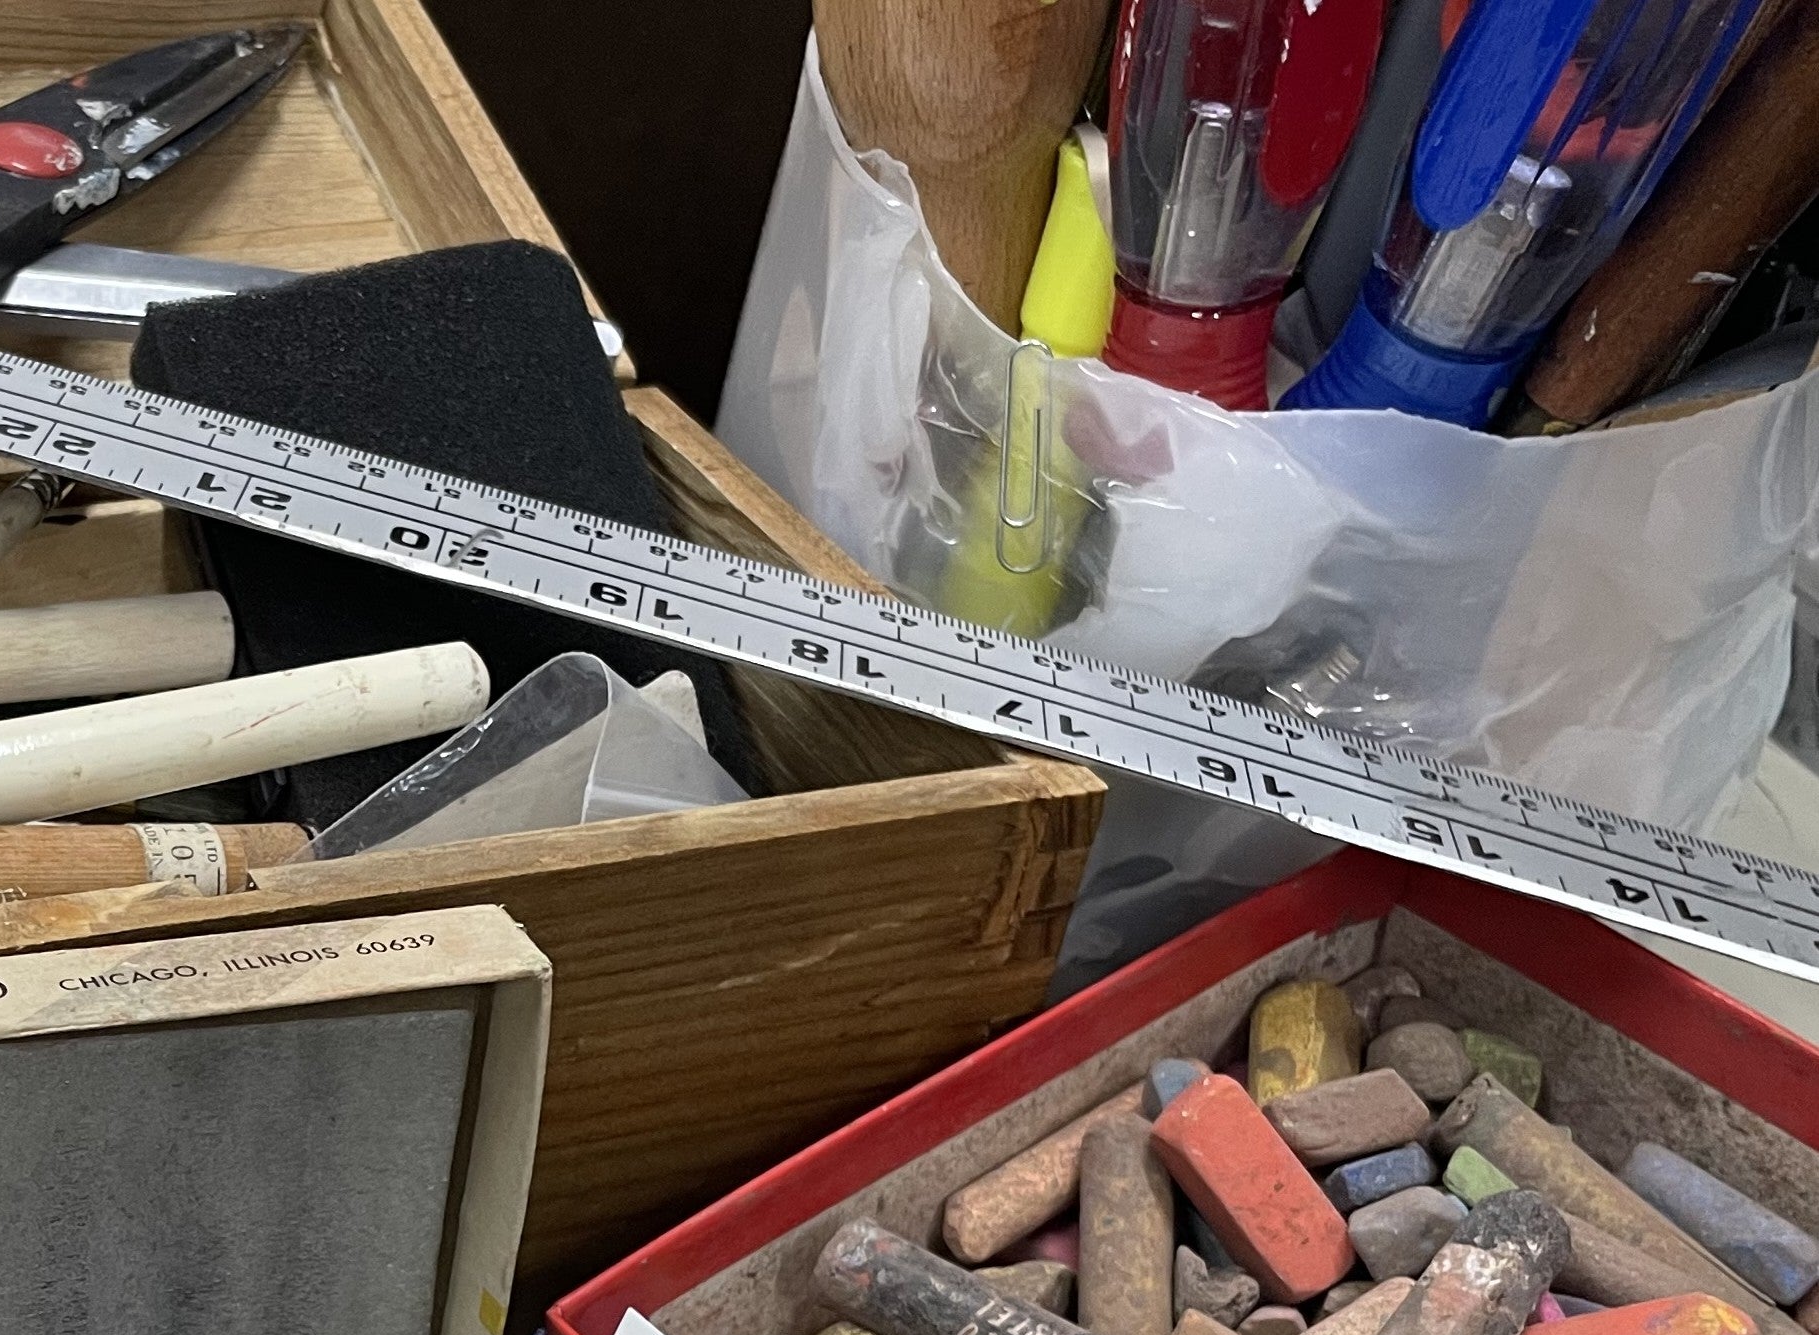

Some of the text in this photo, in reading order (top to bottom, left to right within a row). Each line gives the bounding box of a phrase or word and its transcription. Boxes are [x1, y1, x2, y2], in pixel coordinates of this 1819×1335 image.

[47, 377, 87, 396] 56
[121, 398, 161, 416] 55
[197, 418, 236, 437] 54
[272, 439, 312, 458] 53
[194, 469, 290, 512] 21
[345, 460, 385, 480] 52
[421, 481, 460, 501] 51
[496, 502, 536, 522] 50
[387, 522, 489, 568] 20
[587, 579, 687, 622] 19
[787, 636, 888, 681] 18
[994, 696, 1093, 741] 17
[1192, 753, 1298, 800] 16
[1397, 814, 1504, 864] 15
[1602, 877, 1711, 924] 14
[58, 934, 436, 992] CHICAGO, ILLINOIS 60639
